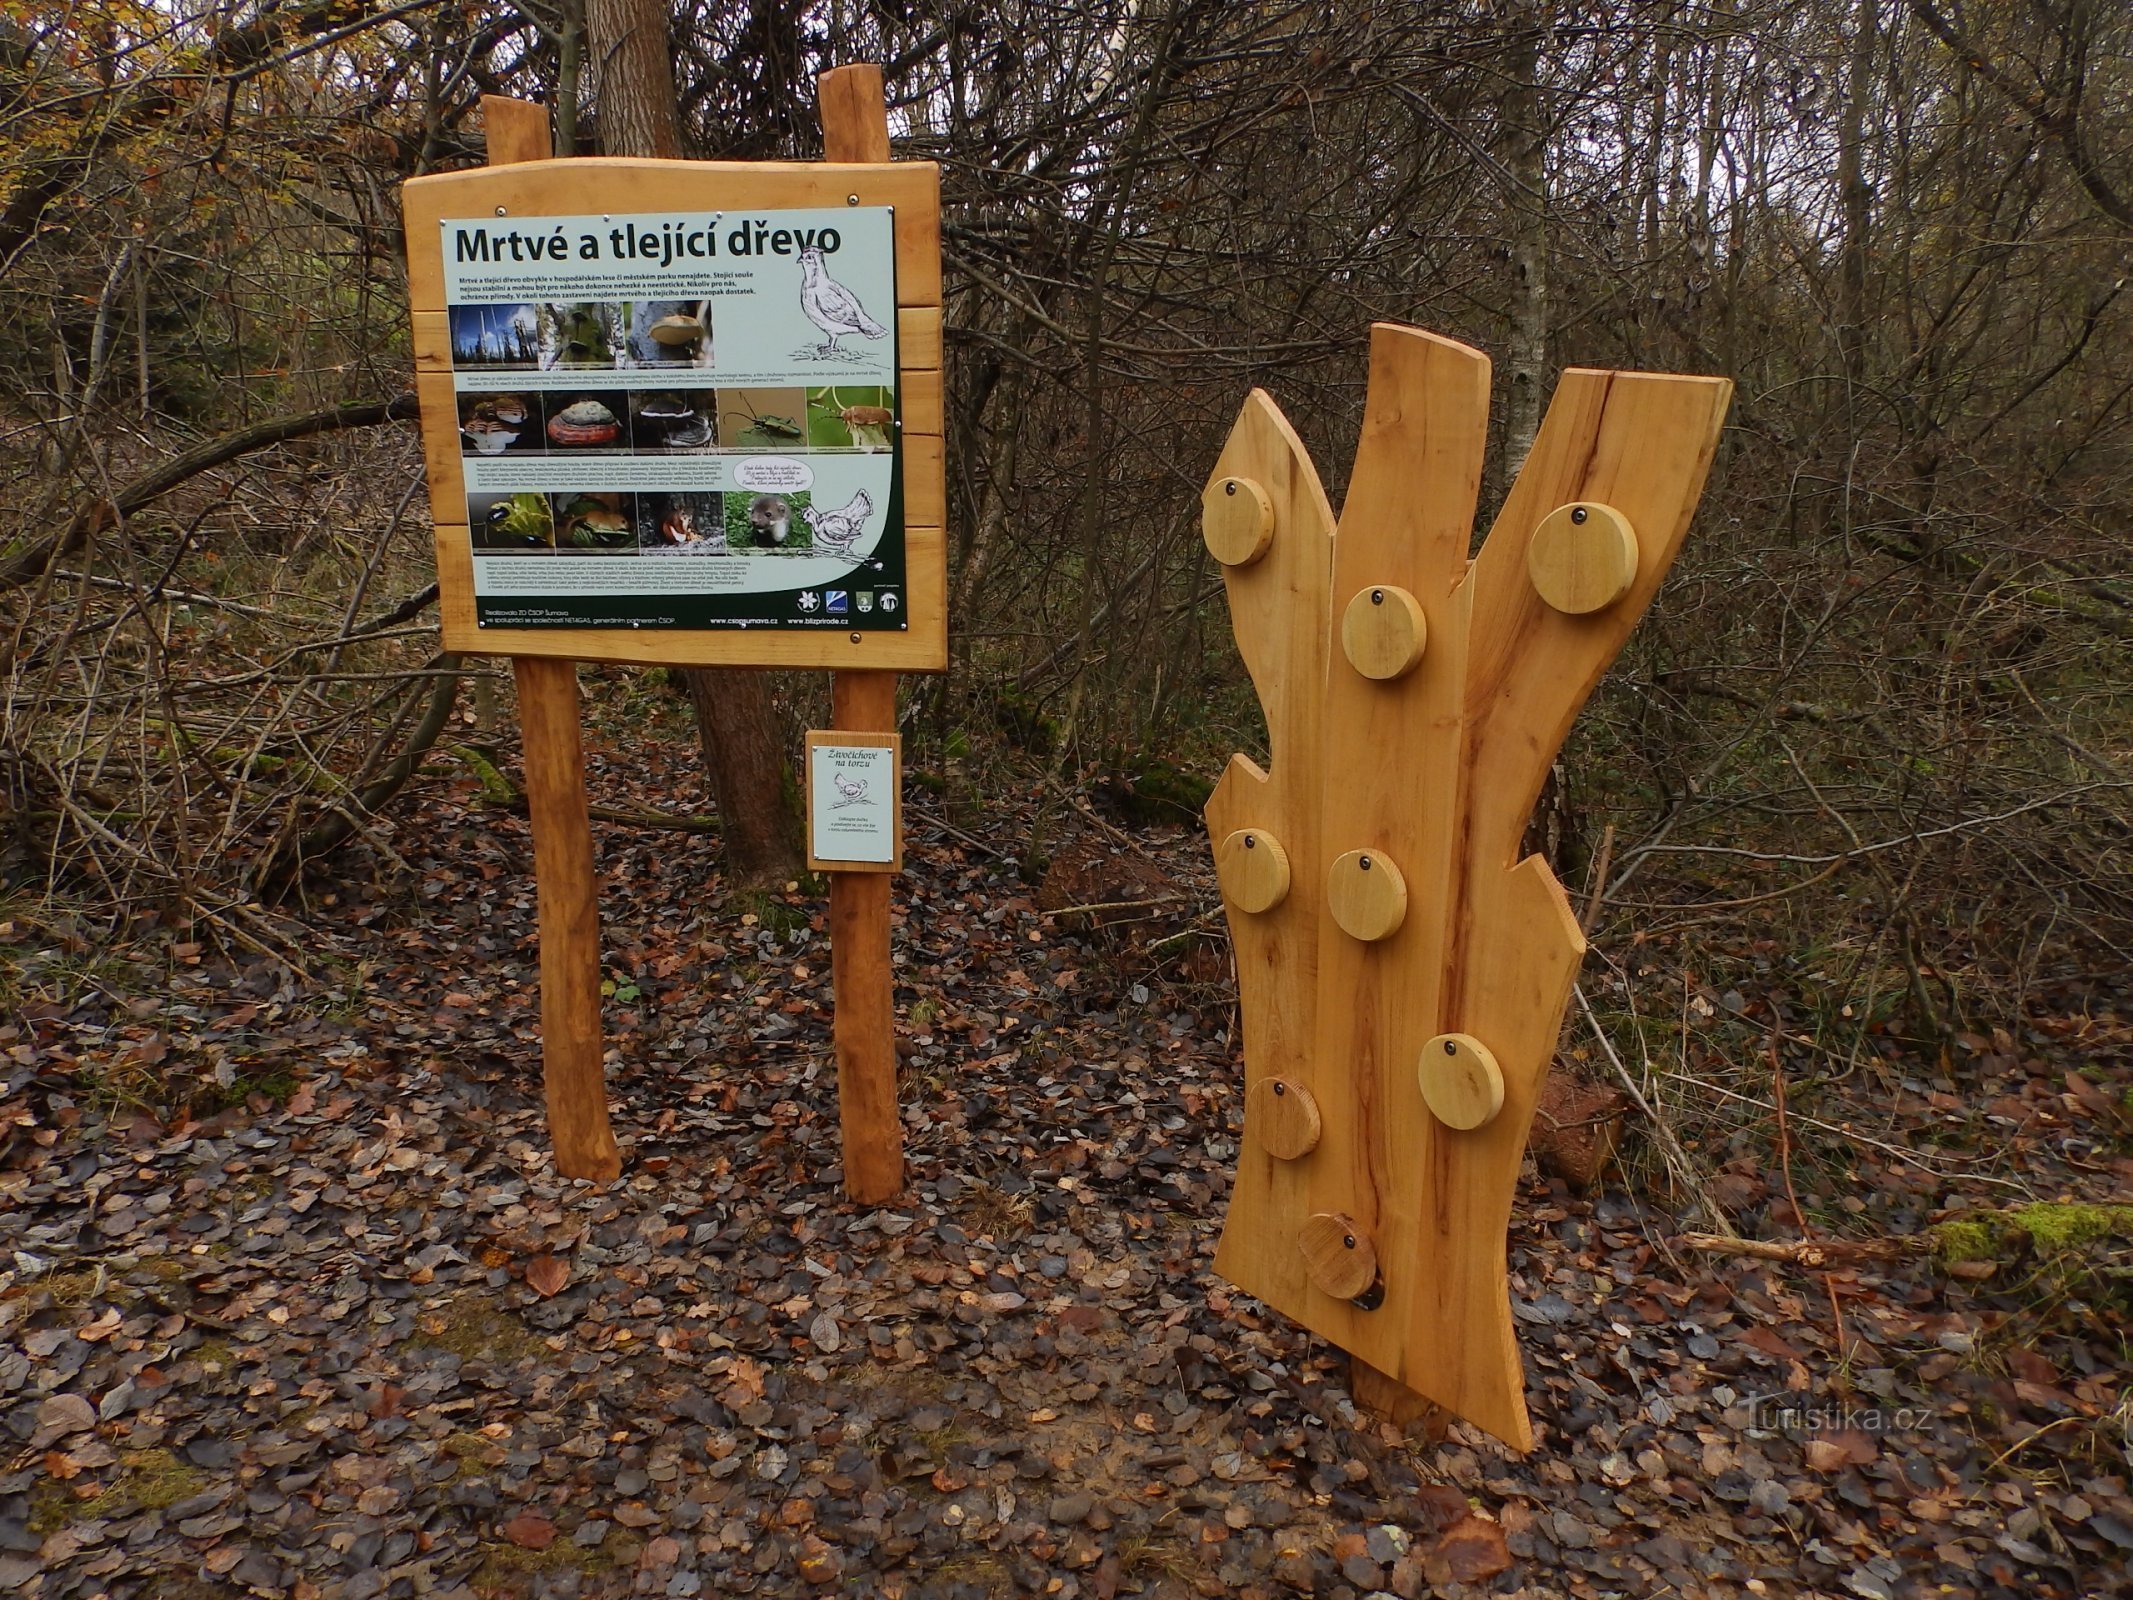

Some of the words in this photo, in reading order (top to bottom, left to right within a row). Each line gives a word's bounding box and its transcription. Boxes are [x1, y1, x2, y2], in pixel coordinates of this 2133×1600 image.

[456, 225, 568, 263] Mrtvé
[579, 233, 600, 260] a
[609, 221, 717, 268] tlející
[727, 219, 841, 257] dřevo
[503, 276, 522, 284] dřevo
[522, 275, 548, 285] obvykle
[554, 274, 602, 285] hospodářském
[602, 274, 616, 282] lese
[623, 273, 656, 281] městském
[657, 272, 677, 281] parku
[677, 271, 712, 280] nenajdete.
[734, 270, 754, 279] souše
[459, 285, 481, 293] nejsou
[512, 284, 535, 292] mohou
[547, 285, 559, 293] pro
[559, 283, 585, 291] někoho
[585, 282, 613, 291] dokonce
[614, 281, 641, 290] nehezké
[687, 280, 710, 288] Nikoliv
[711, 281, 723, 289] pro
[593, 290, 618, 299] najdete
[619, 289, 647, 298] mrtvého
[680, 288, 699, 296] dřeva
[699, 287, 724, 297] naopak
[725, 286, 757, 296] dostatek.
[828, 748, 878, 760] Živočichové
[848, 759, 871, 768] torzu
